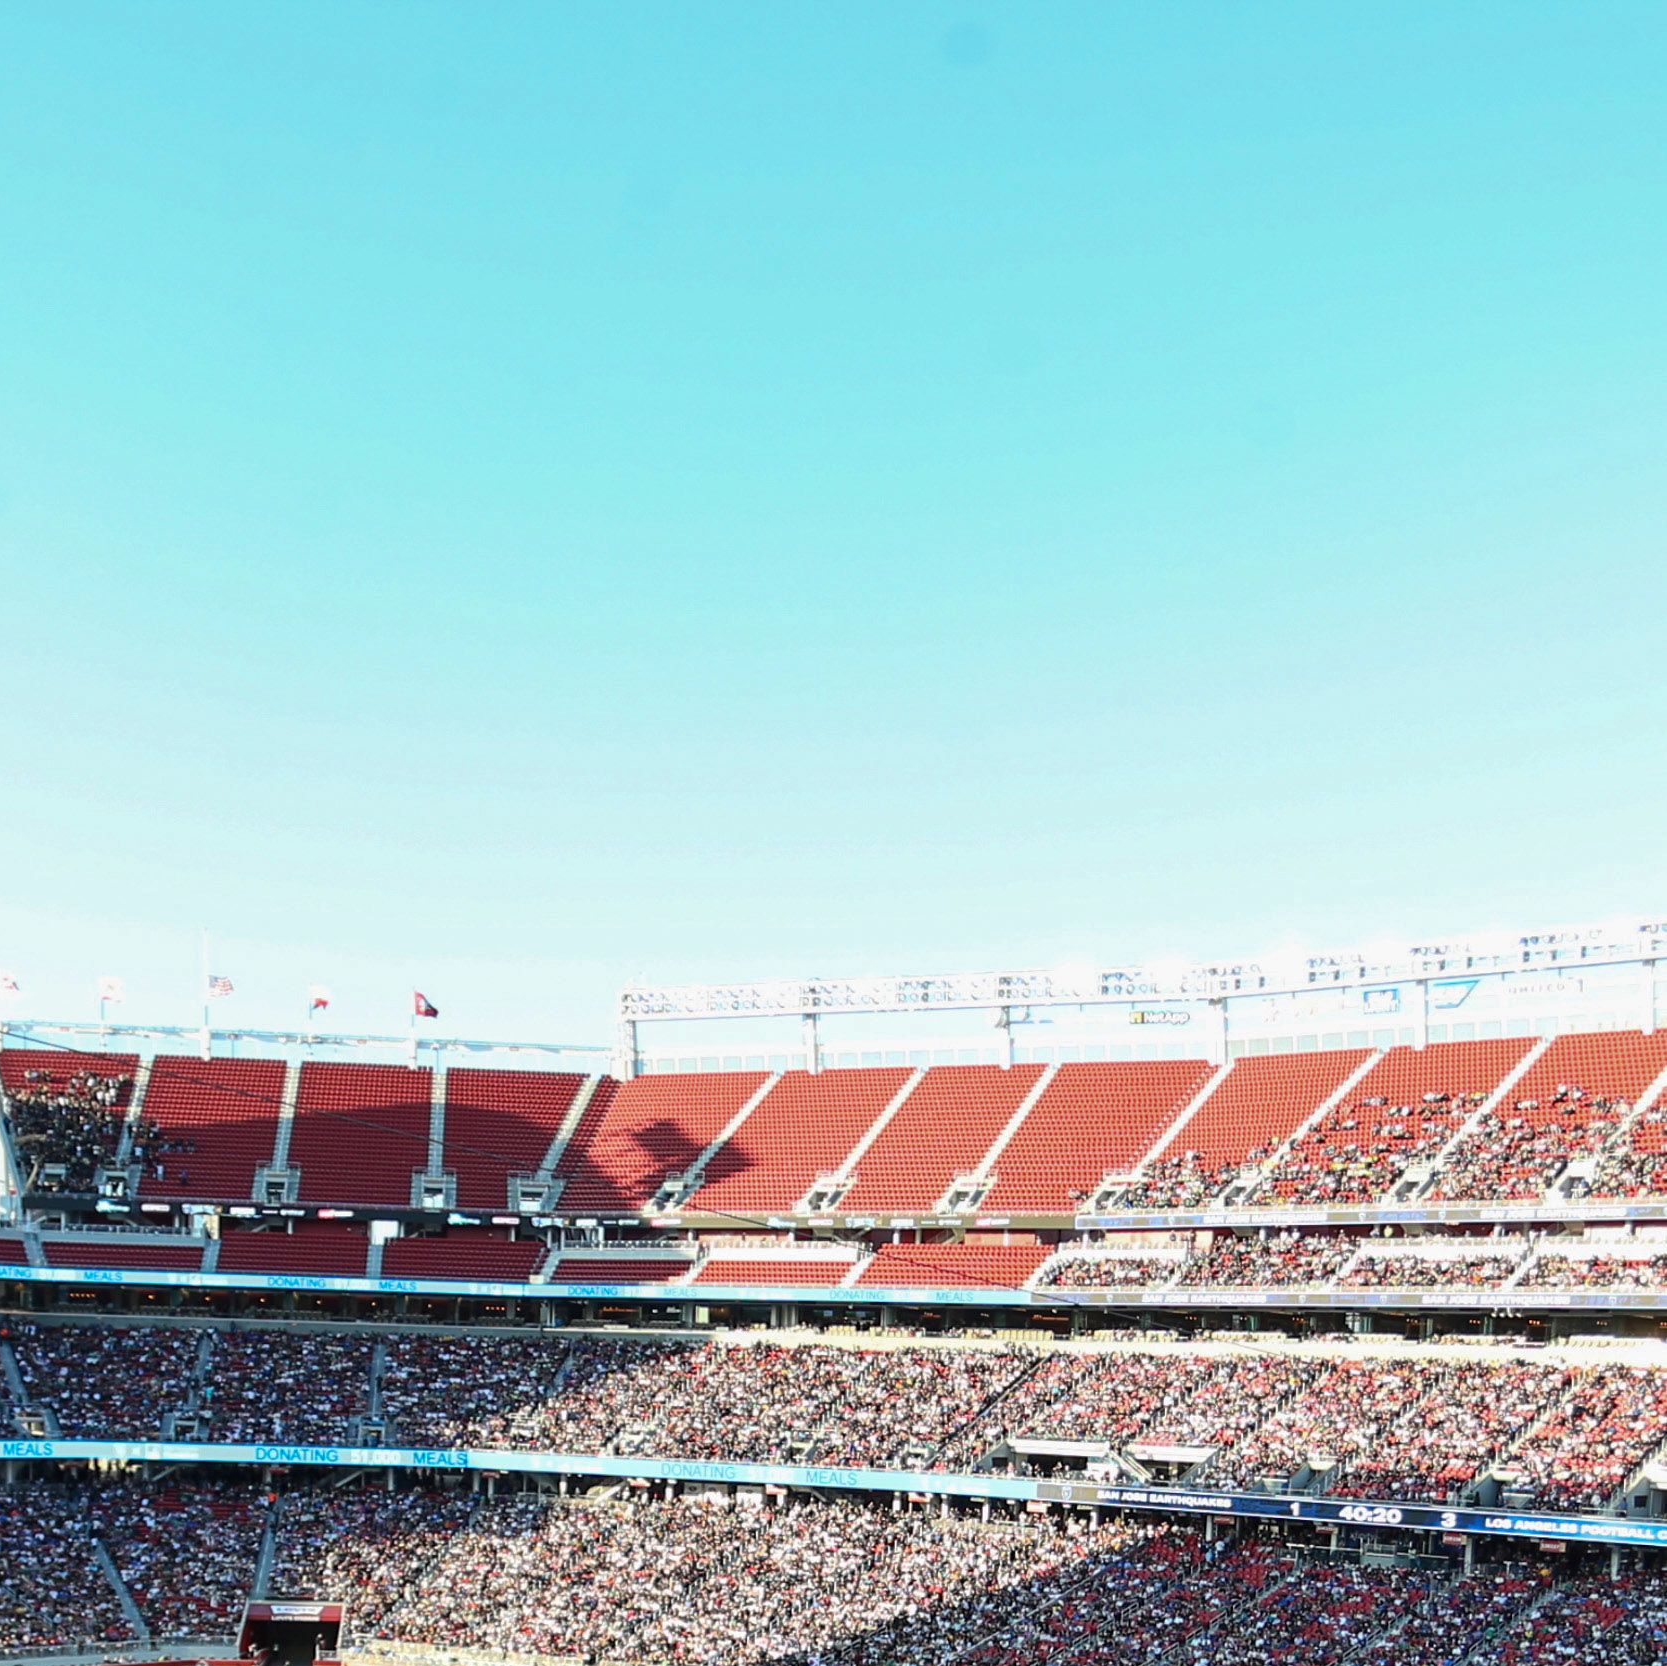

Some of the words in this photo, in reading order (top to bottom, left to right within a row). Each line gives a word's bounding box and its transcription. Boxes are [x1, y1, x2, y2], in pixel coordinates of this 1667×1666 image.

[1143, 1010, 1190, 1025] NetApp
[83, 1271, 123, 1282] MEALS
[267, 1277, 325, 1289] DONATING
[378, 1281, 417, 1291] MEALS
[568, 1286, 618, 1296] DONATING
[829, 1290, 885, 1301] DONATING
[936, 1291, 975, 1302] MEALS
[2, 1443, 53, 1456] MEALS
[255, 1447, 338, 1462] DONATING
[414, 1451, 468, 1467] MEALS
[661, 1463, 734, 1480] DONATING
[805, 1470, 857, 1486] MEALS
[1097, 1489, 1119, 1500] SAN
[1121, 1491, 1148, 1503] JOSE
[1149, 1492, 1232, 1509] EARTHQUAKES
[1290, 1502, 1300, 1516] 1
[1338, 1505, 1402, 1524] 40:20
[1441, 1512, 1457, 1528] 3
[1485, 1517, 1512, 1530] LOS
[1515, 1520, 1578, 1534] ANGELES
[1580, 1524, 1655, 1540] FOOTBALL
